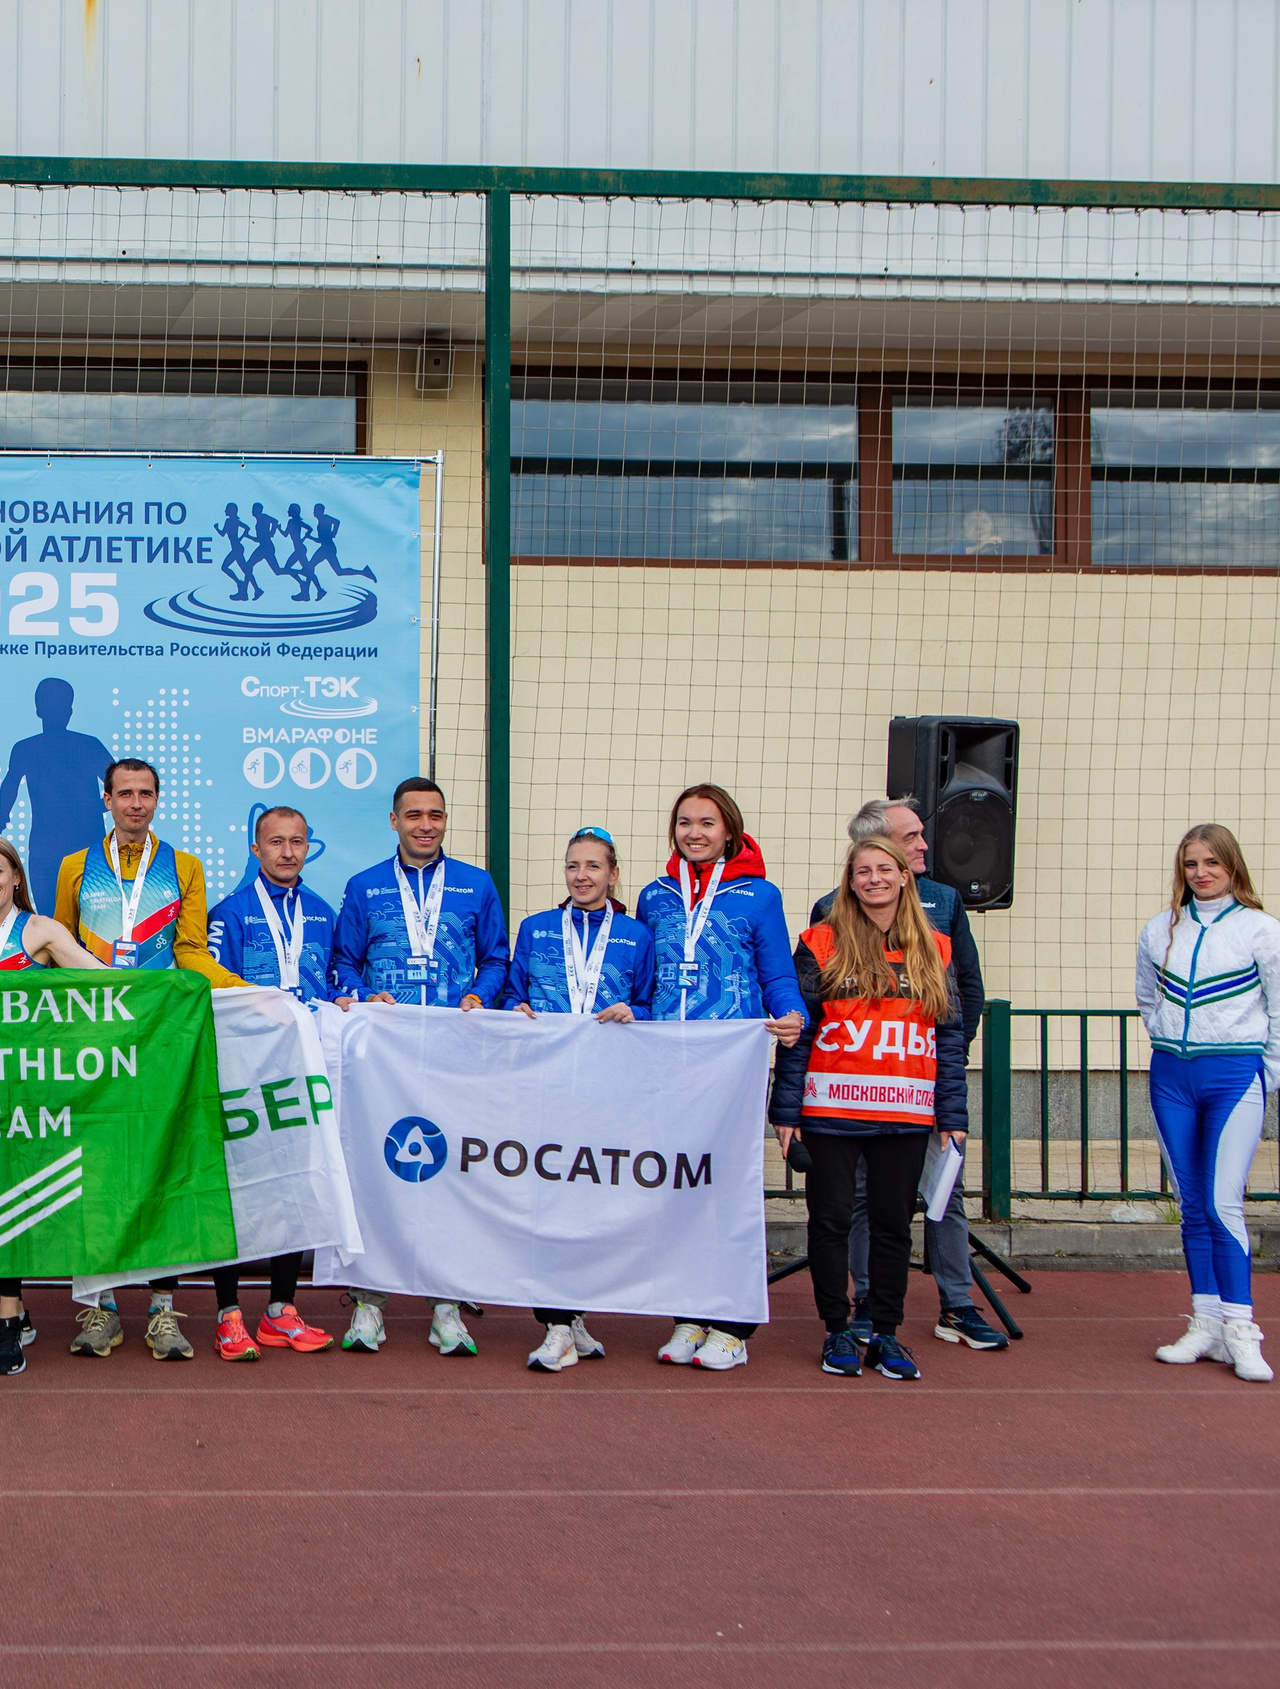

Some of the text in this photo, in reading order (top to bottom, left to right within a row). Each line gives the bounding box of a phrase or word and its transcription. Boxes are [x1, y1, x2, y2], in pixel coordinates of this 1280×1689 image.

[144, 501, 187, 525] ПО
[38, 535, 213, 564] АТЛЕТИКЕ
[34, 641, 164, 658] Правительства
[170, 641, 271, 658] Российской
[276, 642, 378, 660] Федерации
[242, 727, 378, 745] ВМАРАФОНЕ
[728, 889, 755, 897] САТОМ
[815, 1020, 937, 1061] СУДЬЯ
[219, 1074, 334, 1141] БЕР
[460, 1136, 713, 1190] РОСАТОМ
